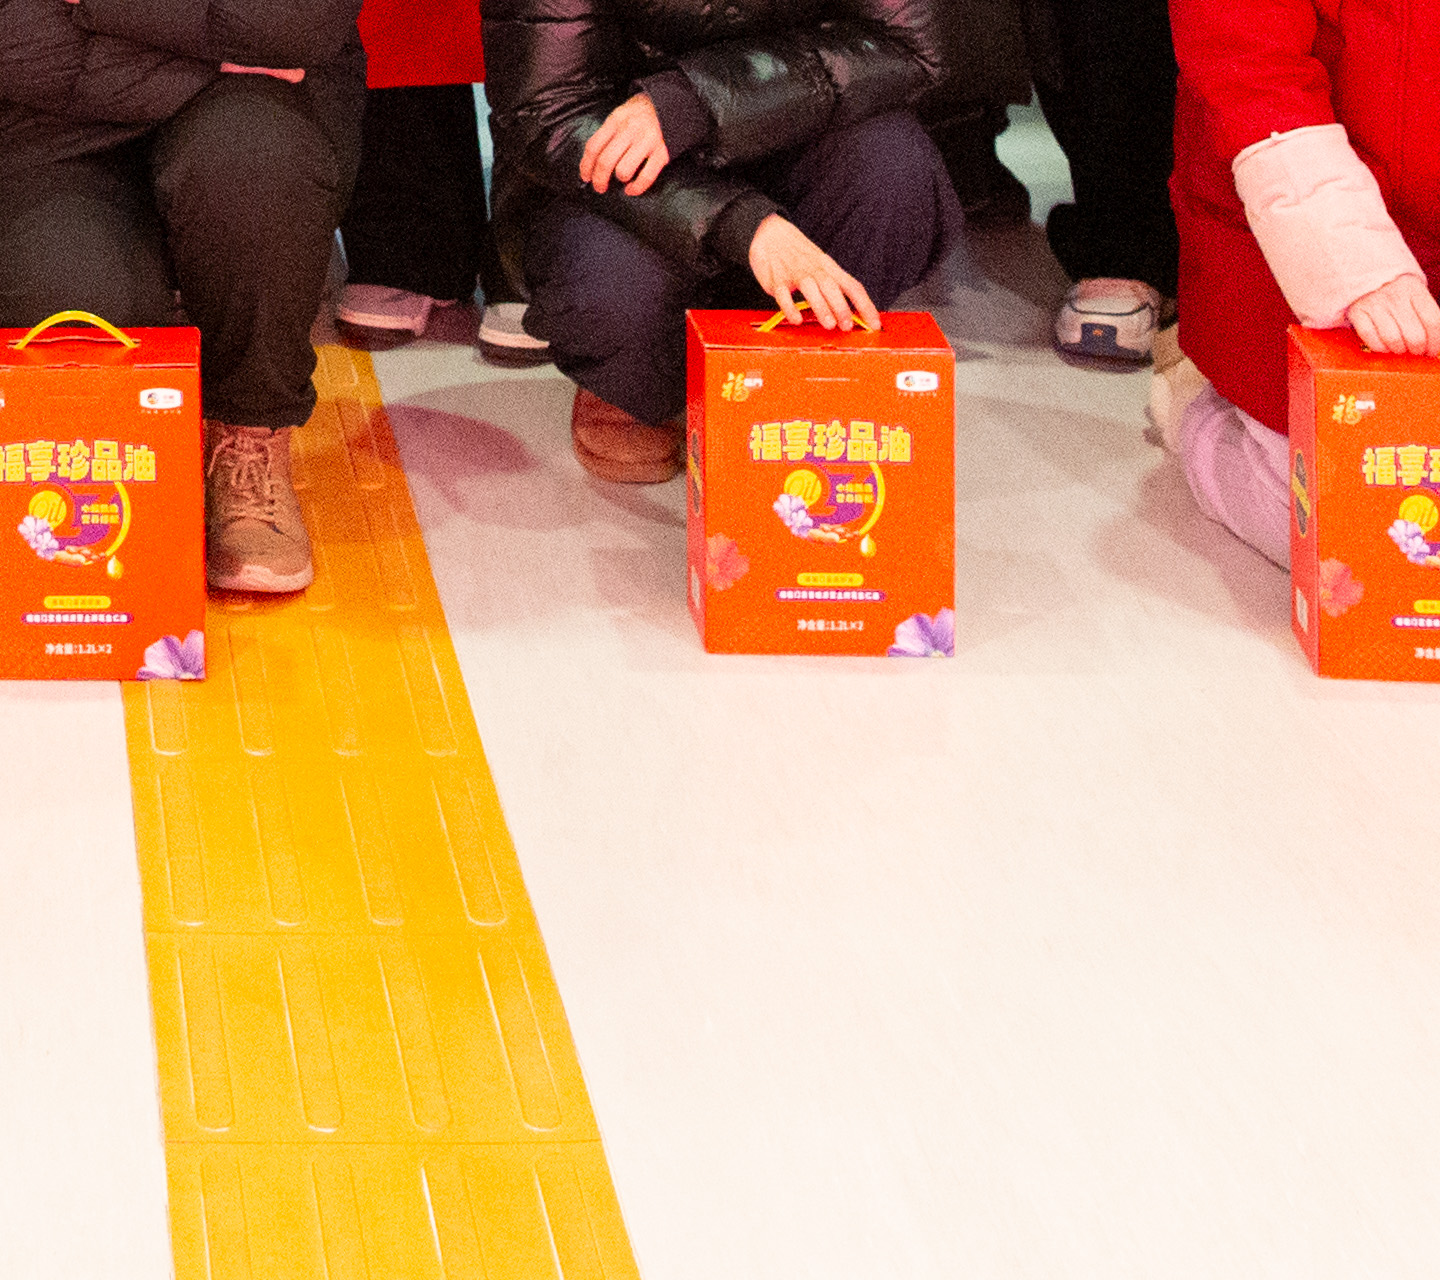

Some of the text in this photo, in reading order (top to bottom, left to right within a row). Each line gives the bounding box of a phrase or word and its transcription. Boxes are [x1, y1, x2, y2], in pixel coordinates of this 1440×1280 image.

[749, 419, 912, 462] 福享珍品油
